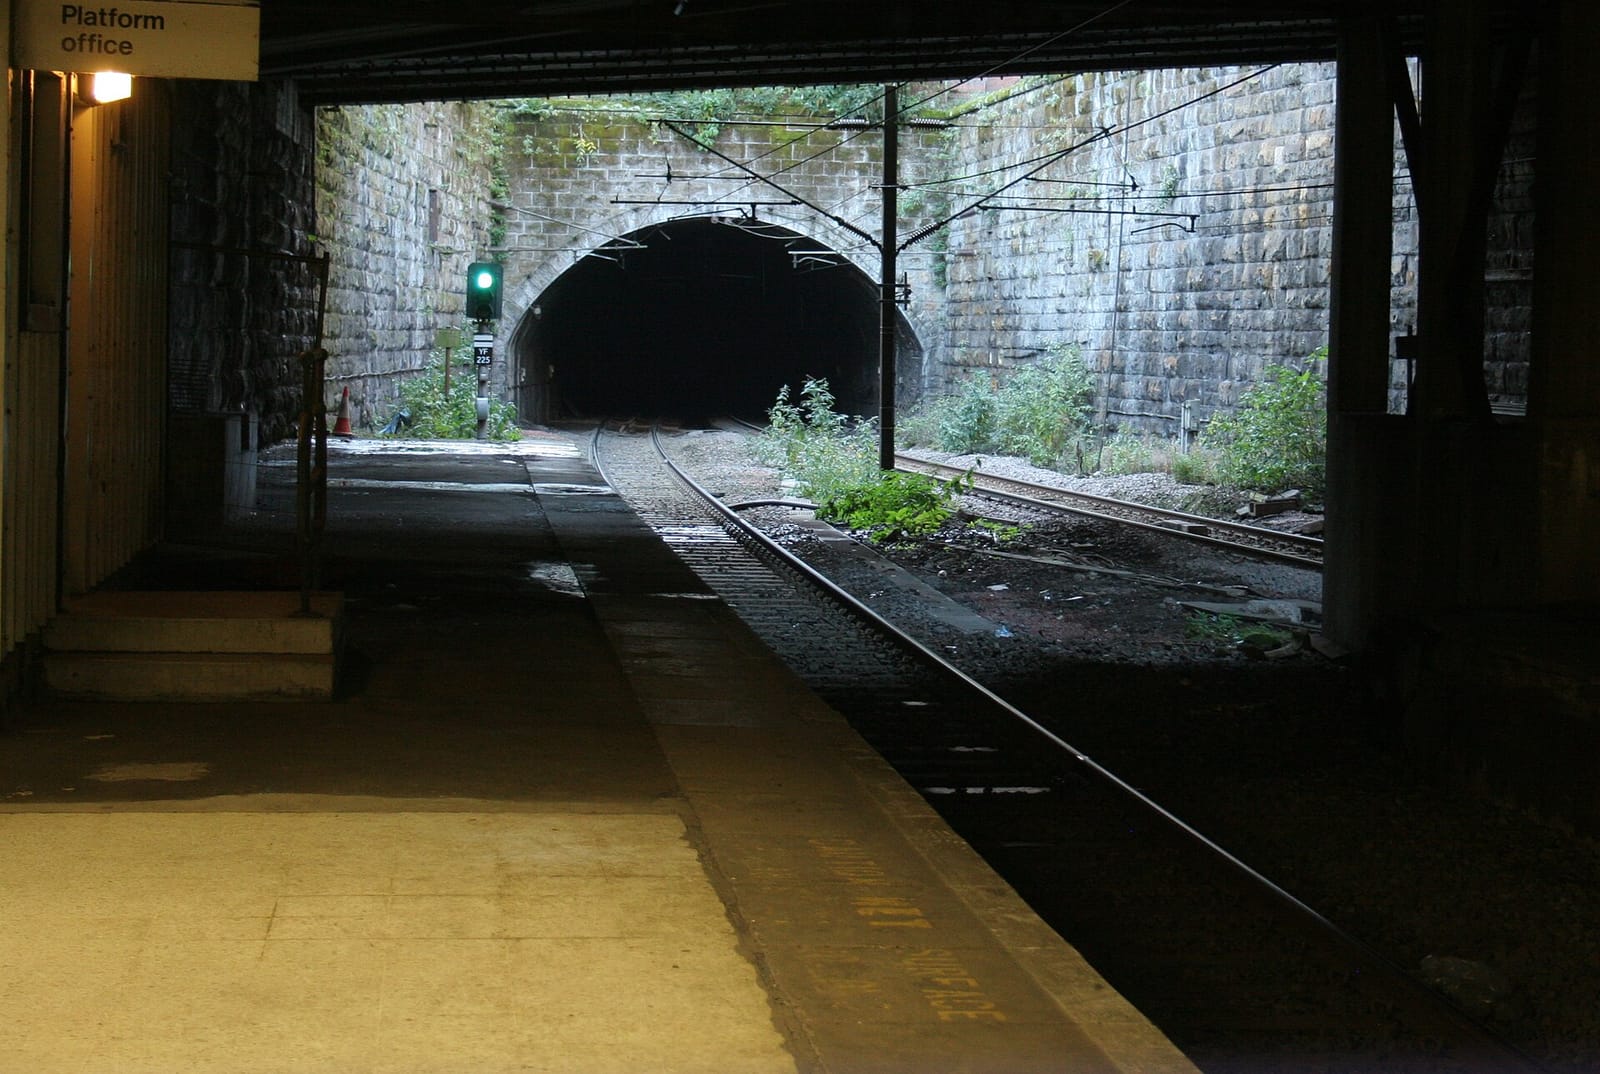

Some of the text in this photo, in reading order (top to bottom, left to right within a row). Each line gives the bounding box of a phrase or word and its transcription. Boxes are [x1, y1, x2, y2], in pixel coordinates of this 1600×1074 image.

[62, 5, 164, 30] Platform
[62, 33, 133, 55] office
[476, 356, 491, 364] 225
